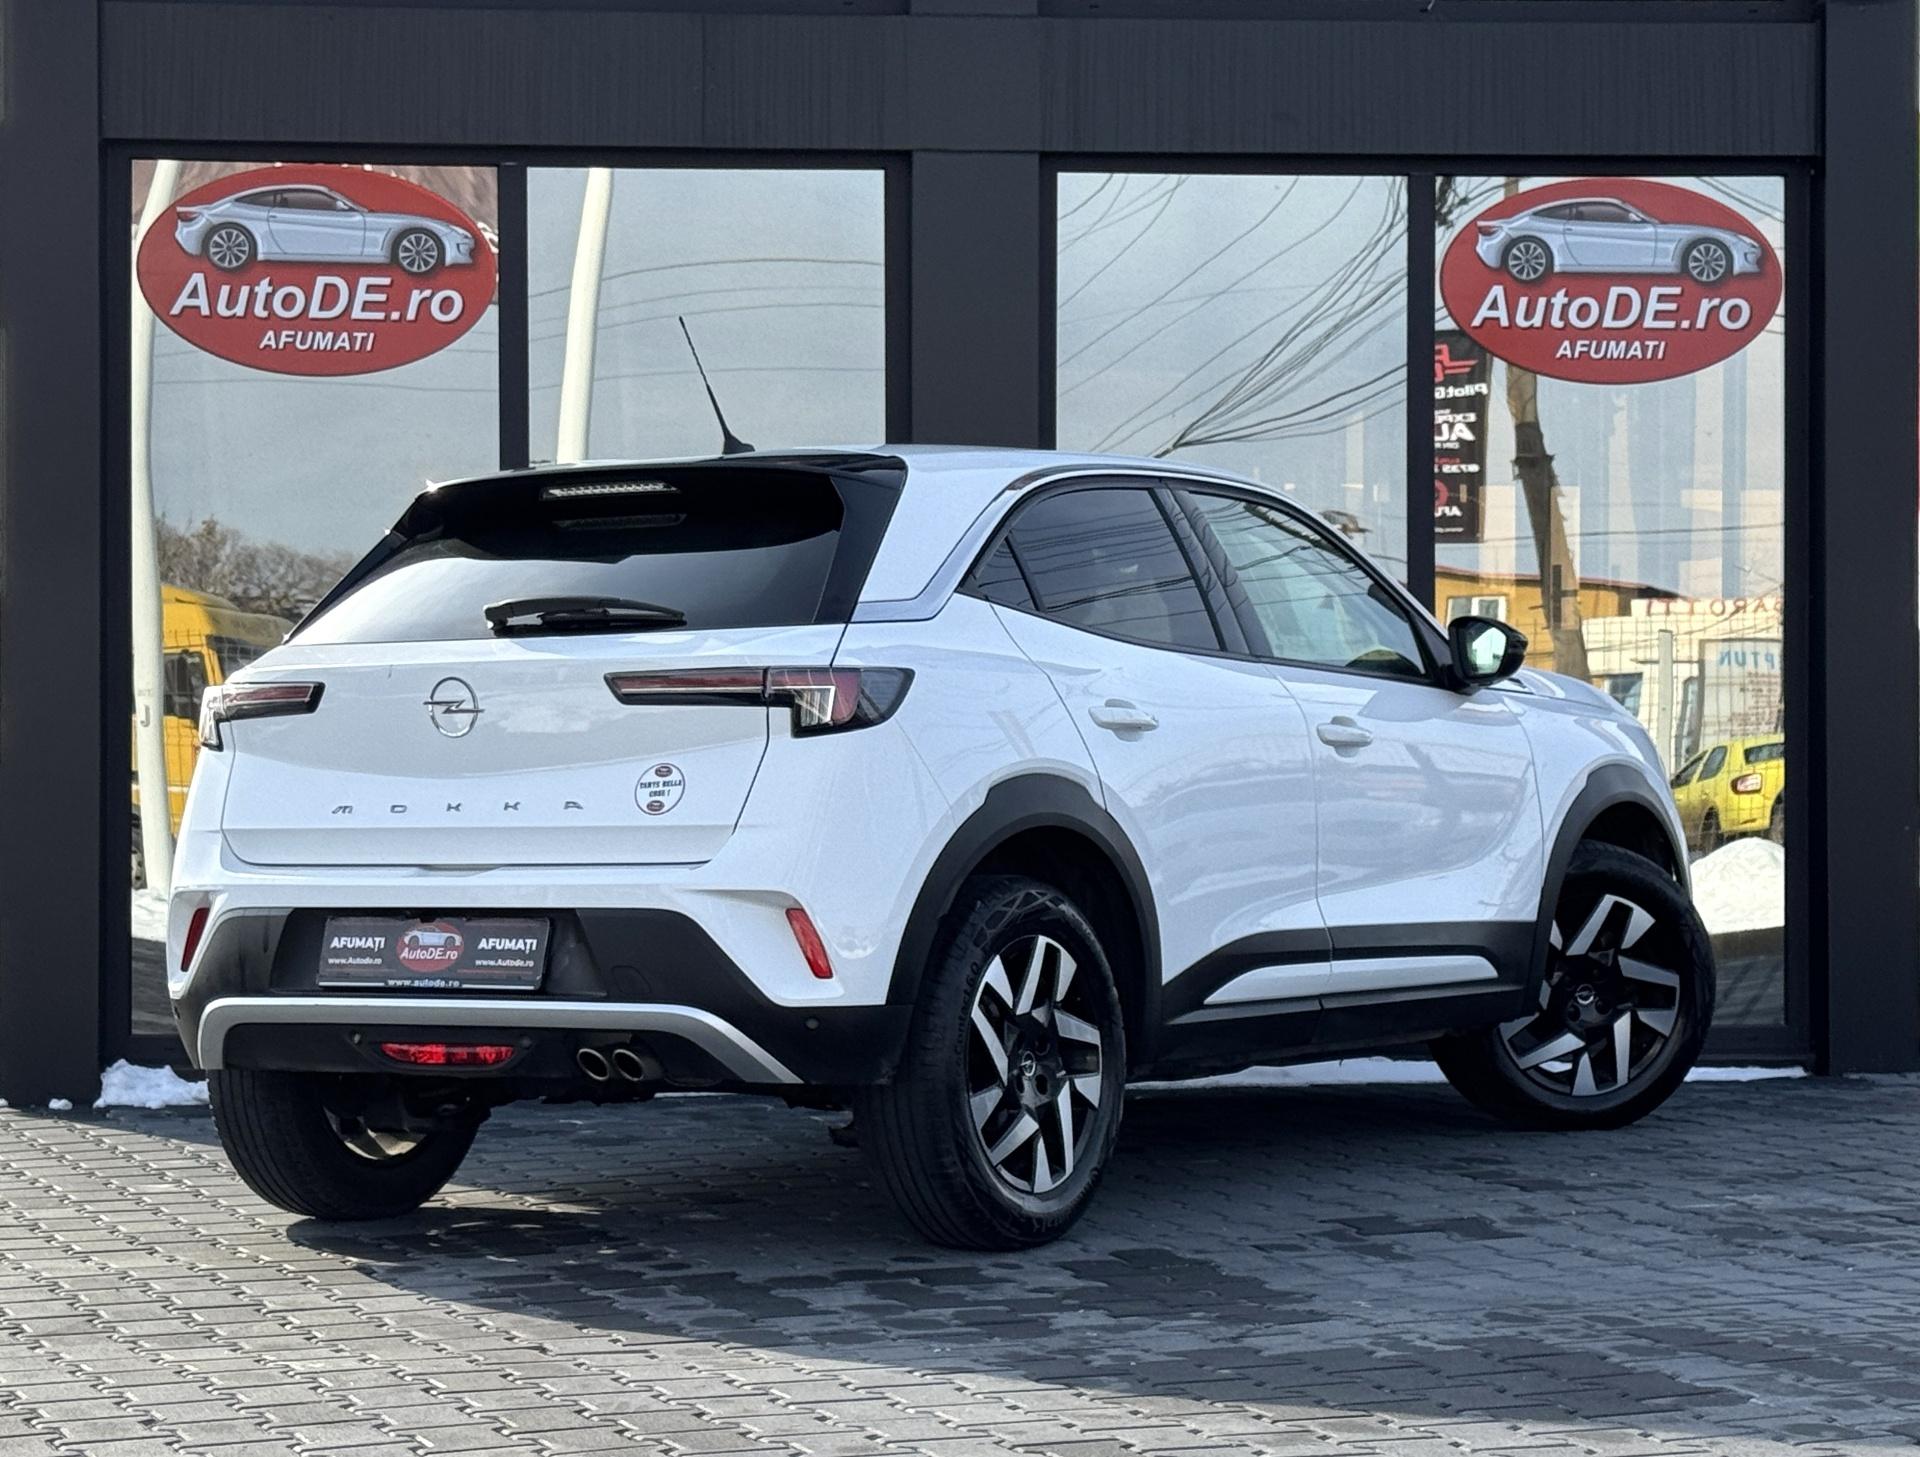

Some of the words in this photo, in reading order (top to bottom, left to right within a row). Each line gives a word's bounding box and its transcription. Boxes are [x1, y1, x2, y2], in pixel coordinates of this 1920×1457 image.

[170, 272, 464, 323] AutoDE.ro
[1471, 284, 1752, 331] AutoDE.ro
[258, 330, 376, 352] AFUMATI
[1555, 339, 1666, 360] AFUMATI
[331, 799, 584, 815] MOKKA
[400, 947, 458, 960] AutoDE.ro
